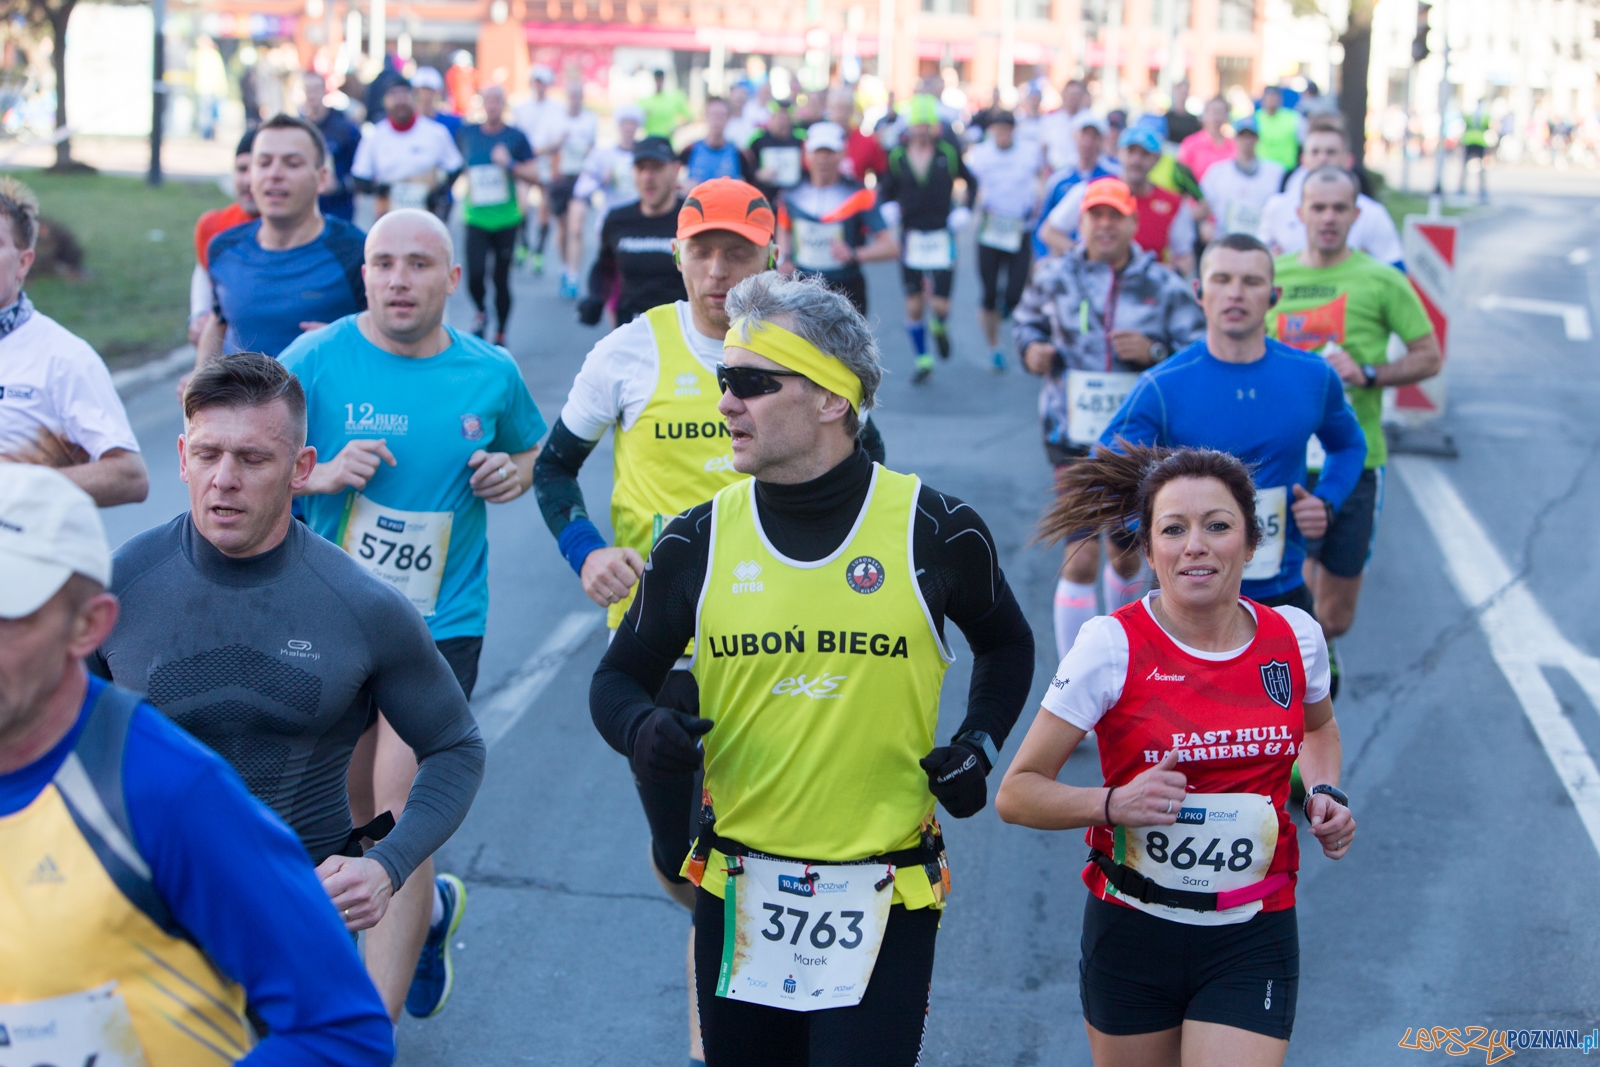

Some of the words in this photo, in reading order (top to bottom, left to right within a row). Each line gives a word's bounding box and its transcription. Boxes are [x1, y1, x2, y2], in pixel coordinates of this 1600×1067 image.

[344, 402, 375, 424] 12
[358, 531, 433, 572] 5786
[708, 624, 805, 659] LUBOŃ
[817, 629, 909, 659] BIEGA
[280, 648, 321, 661] Kalenji
[1154, 672, 1186, 682] Scimitar
[1171, 729, 1232, 748] EAST
[1235, 725, 1292, 743] HULL
[1264, 742, 1282, 756] &
[1184, 811, 1203, 821] PKO
[1145, 830, 1254, 873] 8648
[781, 879, 793, 889] 10.
[793, 881, 811, 892] PKO
[1182, 876, 1209, 887] Sara
[761, 901, 865, 950] 3763
[793, 952, 828, 966] Marek
